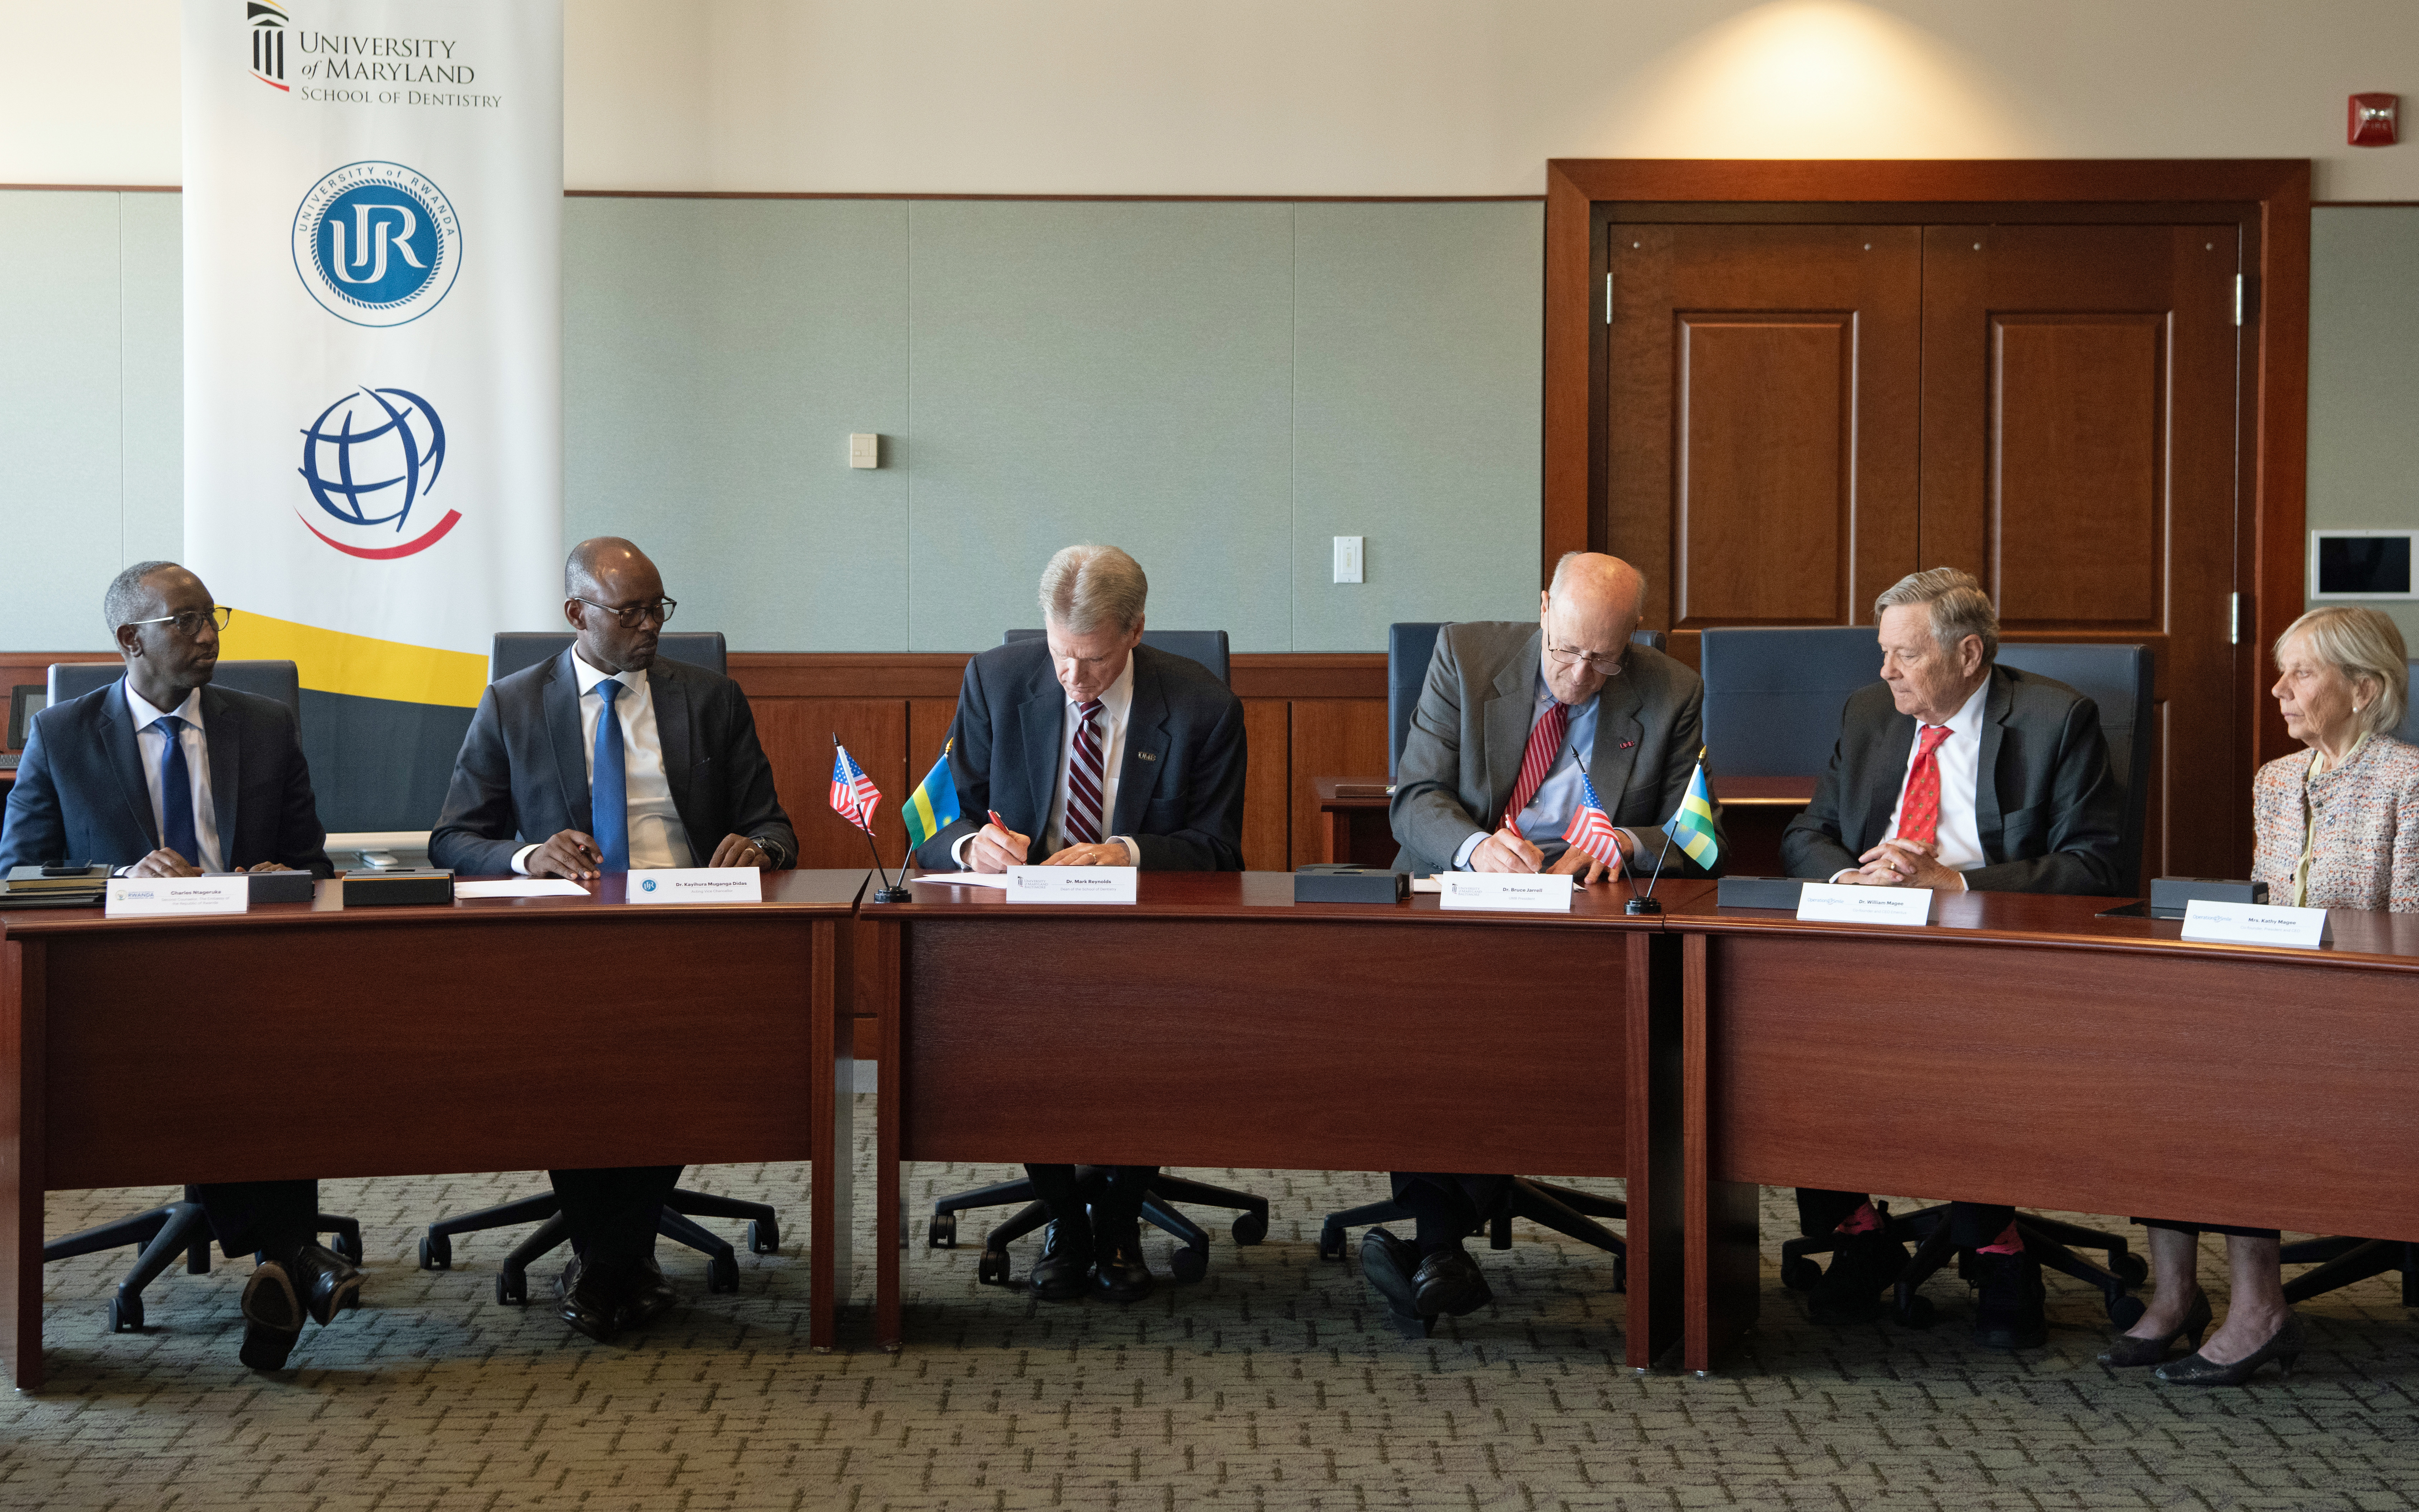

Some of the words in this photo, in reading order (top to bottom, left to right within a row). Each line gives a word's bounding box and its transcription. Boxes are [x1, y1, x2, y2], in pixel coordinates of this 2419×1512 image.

[299, 31, 457, 59] UNIVERSITY
[302, 60, 322, 79] of
[326, 58, 474, 84] MARYLAND
[301, 86, 372, 103] SCHOOL
[379, 90, 400, 104] OF
[409, 91, 502, 108] DENTISTRY
[299, 166, 374, 232] UNIVERSITY
[411, 177, 455, 236] RWANDA
